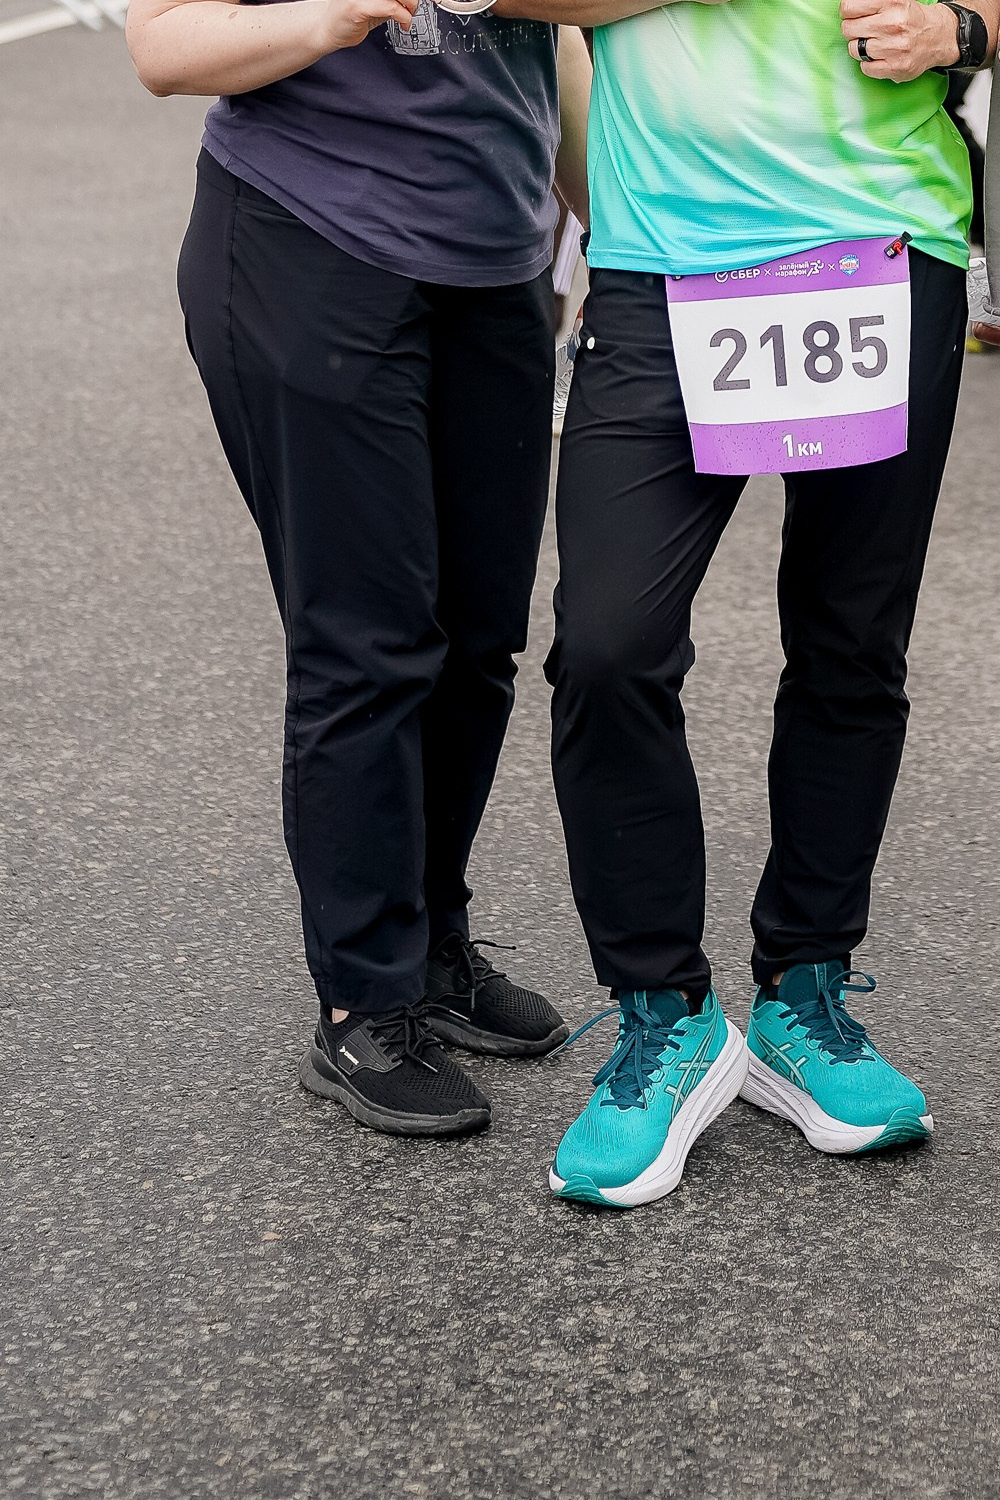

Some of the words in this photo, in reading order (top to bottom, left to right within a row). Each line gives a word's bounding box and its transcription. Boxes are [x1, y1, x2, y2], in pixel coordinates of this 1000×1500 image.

[730, 268, 761, 280] СБЕР
[779, 261, 810, 271] зелёный
[775, 269, 808, 278] марафон
[709, 314, 888, 392] 2185
